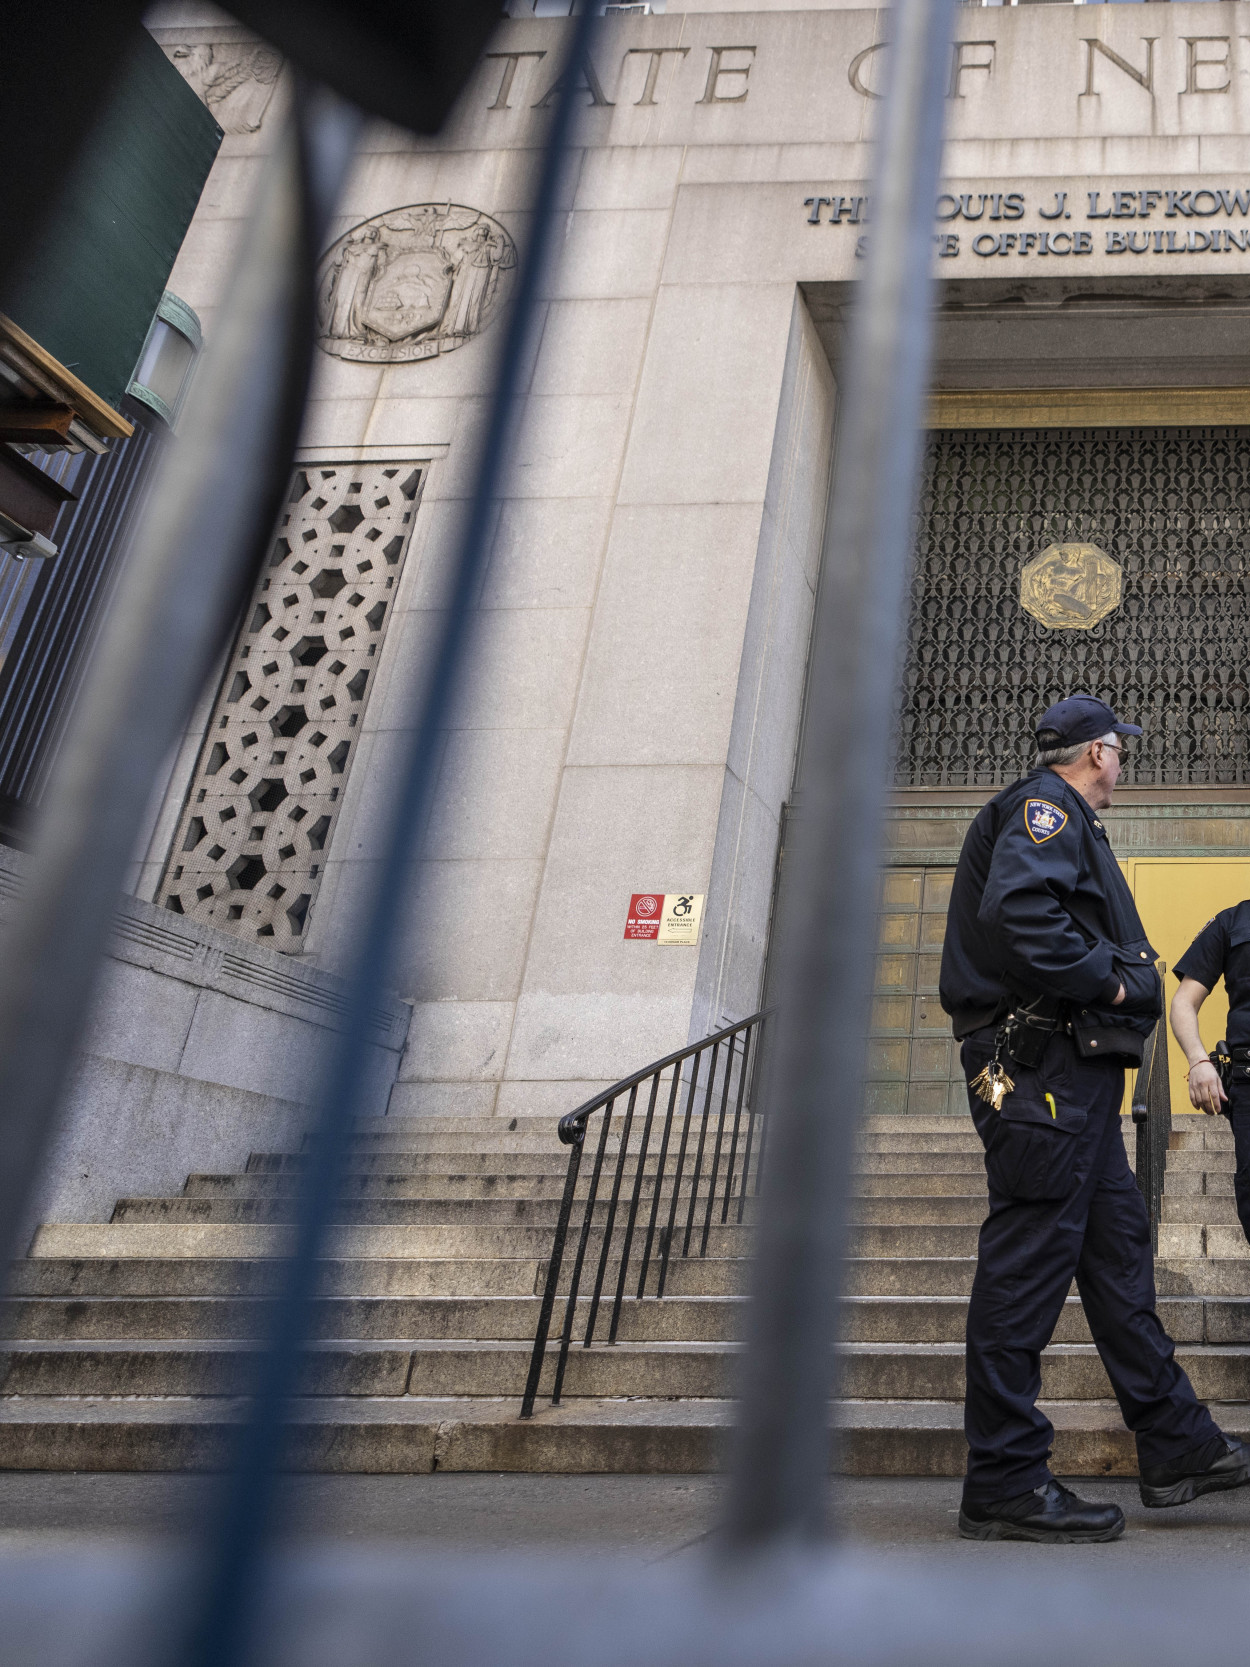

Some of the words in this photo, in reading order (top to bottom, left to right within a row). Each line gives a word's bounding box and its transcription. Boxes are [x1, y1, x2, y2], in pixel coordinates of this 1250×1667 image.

[485, 44, 758, 110] TATE
[803, 196, 872, 224] TH
[936, 192, 1025, 221] OUIS
[1038, 191, 1072, 220] J.
[971, 231, 1093, 257] OFFICE
[347, 344, 433, 360] EXCELSIOR
[1041, 803, 1052, 811] YORK
[1053, 808, 1065, 819] STATE
[1032, 826, 1050, 835] COURTS
